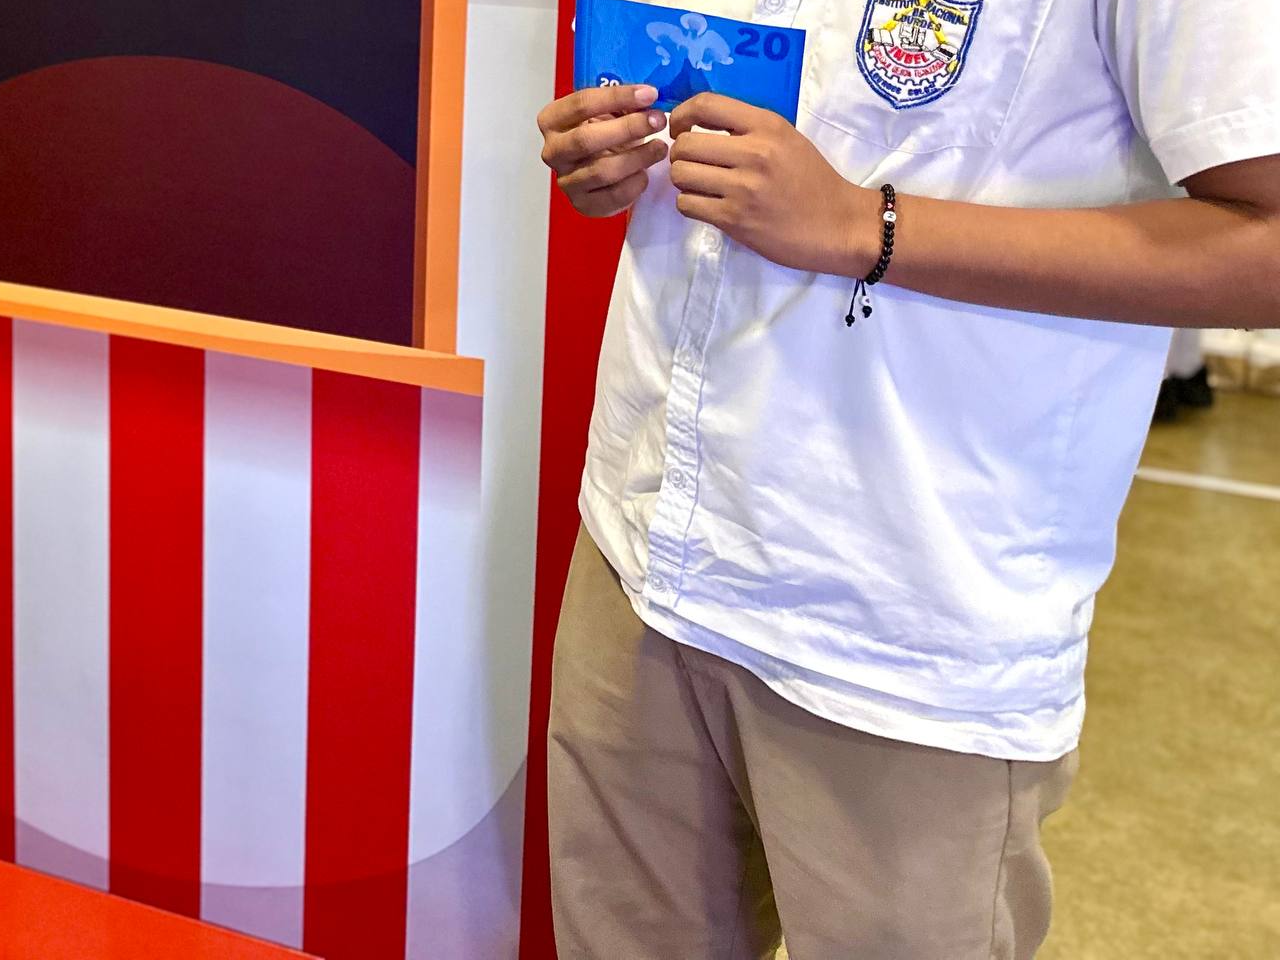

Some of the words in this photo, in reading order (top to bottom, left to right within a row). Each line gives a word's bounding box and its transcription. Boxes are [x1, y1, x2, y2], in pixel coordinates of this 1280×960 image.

[893, 13, 942, 32] LOURDES
[912, 7, 927, 19] DE
[925, 0, 969, 26] NACIONAL
[734, 27, 791, 62] 20
